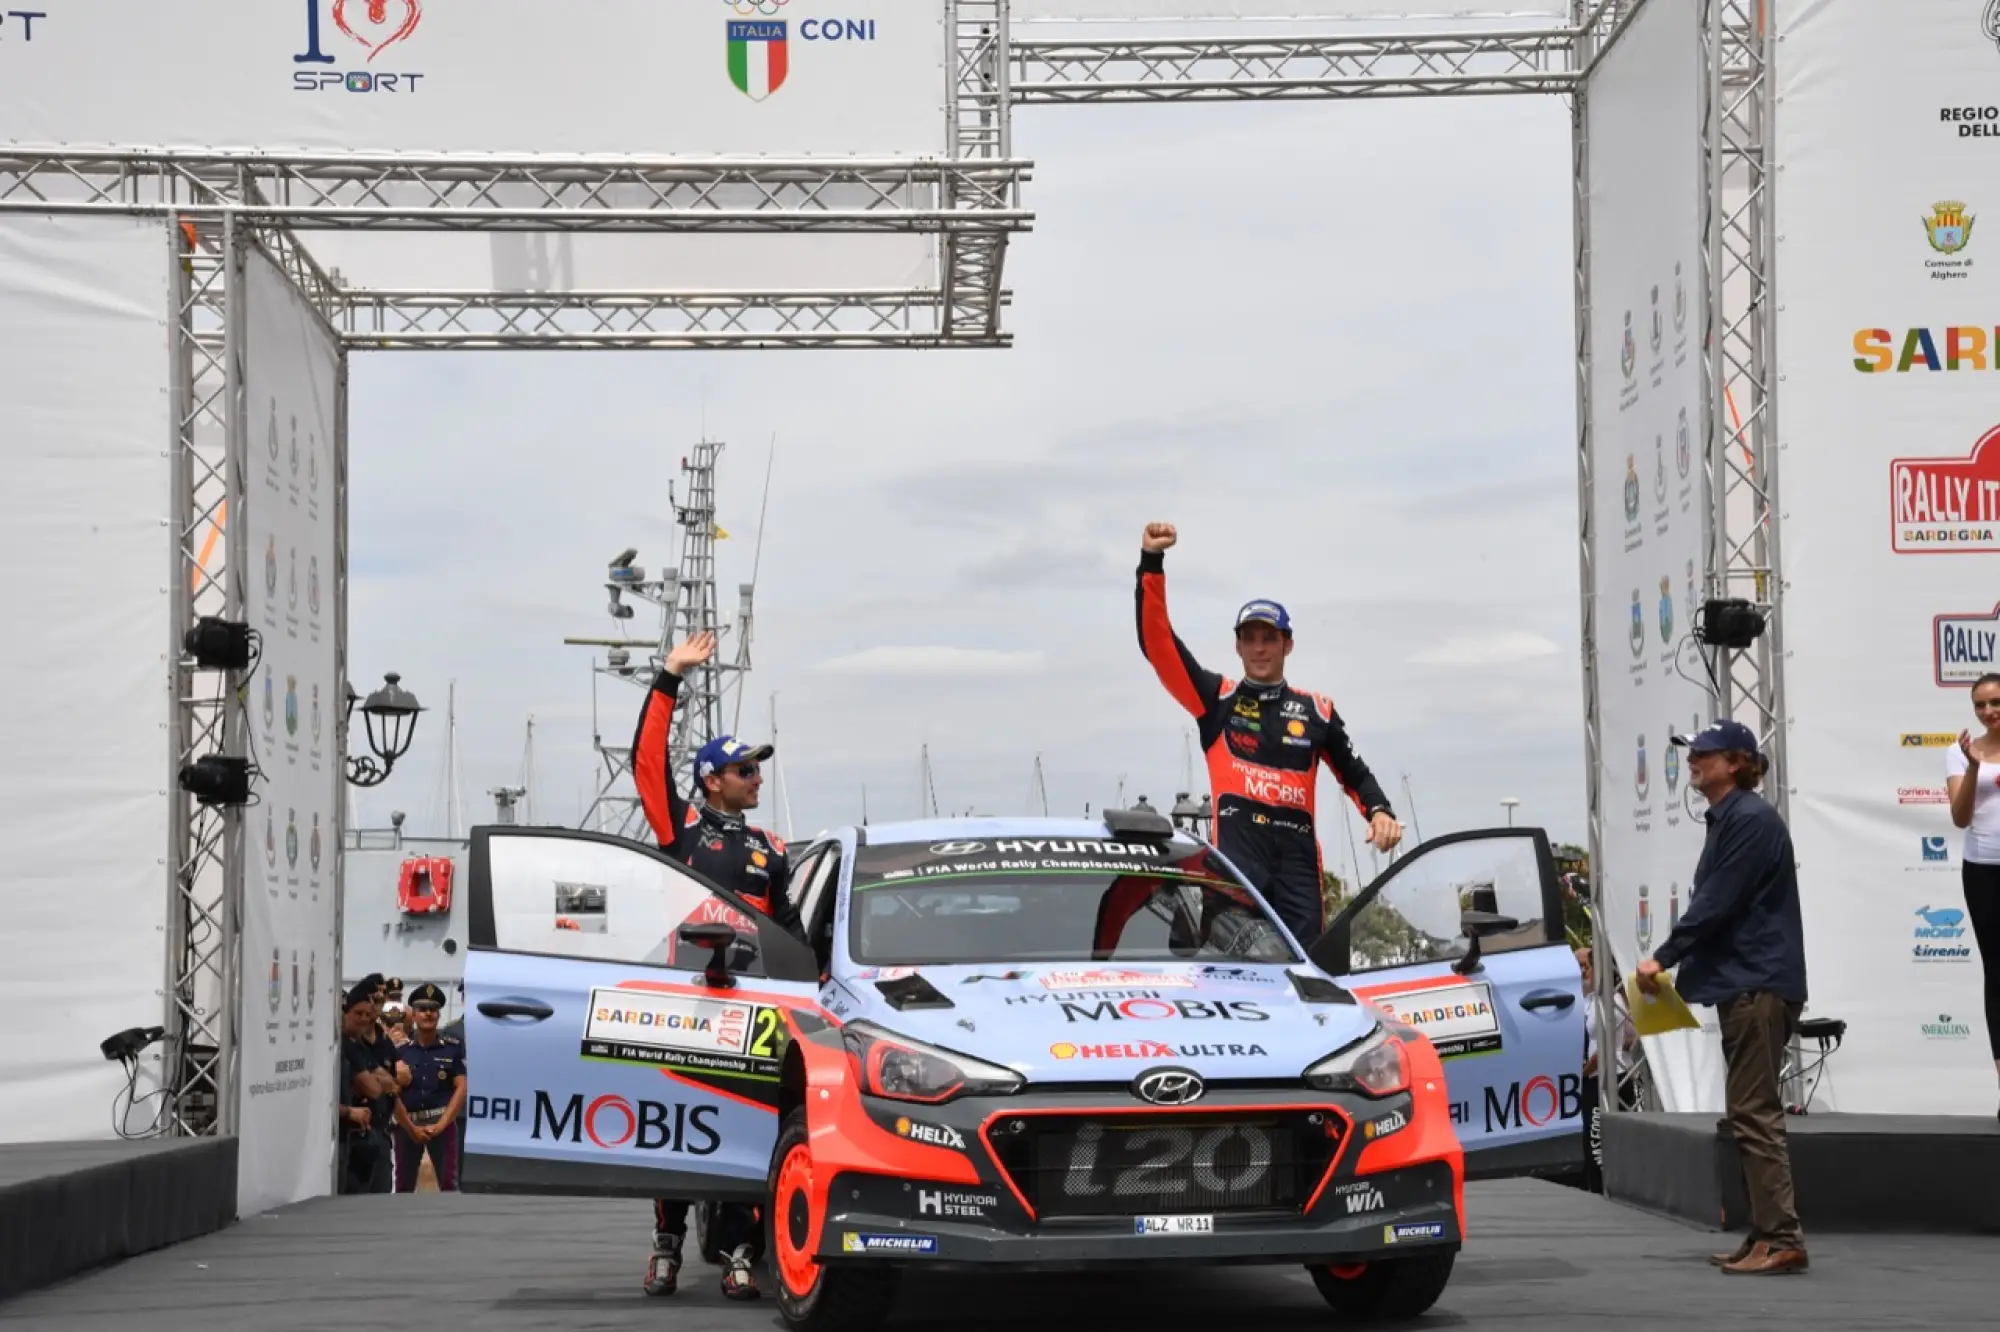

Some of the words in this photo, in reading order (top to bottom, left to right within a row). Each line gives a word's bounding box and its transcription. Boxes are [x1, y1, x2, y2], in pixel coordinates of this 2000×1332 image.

[732, 25, 783, 37] ITALIA
[800, 18, 875, 40] CONI
[293, 71, 424, 93] SPORT
[1940, 106, 1999, 122] REGIO
[1924, 259, 1962, 268] Comune
[1964, 258, 1973, 267] di
[1930, 270, 1968, 280] Alghero
[1853, 325, 2000, 373] SAR
[1898, 466, 1971, 522] RALLY
[1904, 529, 1993, 542] SARDEGNA
[1944, 624, 1996, 663] RALLY
[1244, 778, 1306, 806] MOBIS
[996, 839, 1160, 857] HYUNDAI
[926, 865, 950, 875] FIA
[954, 860, 997, 872] World
[1001, 858, 1037, 870] Rally
[1041, 858, 1143, 873] Championship
[1914, 927, 1966, 939] MOBY
[1911, 944, 1971, 957] tirrenia
[1004, 989, 1161, 1005] HYUNDAI
[1059, 999, 1271, 1023] MOBIS
[1400, 1002, 1490, 1026] SARDEGNA
[596, 1007, 713, 1033] SARDEGNA
[717, 1007, 746, 1049] 2016
[622, 1047, 636, 1057] FIA
[638, 1049, 663, 1061] World
[665, 1053, 686, 1065] Rally
[687, 1054, 747, 1071] Championship
[1081, 1040, 1178, 1059] HELIX
[1178, 1044, 1269, 1057] ULTRA
[531, 1089, 721, 1155] MOBIS
[1375, 1110, 1407, 1136] HELIX
[911, 1123, 967, 1149] HELIX
[1063, 1125, 1273, 1196] i20
[944, 1193, 998, 1206] HYUNDAI
[944, 1204, 984, 1216] STEEL
[1397, 1226, 1441, 1237] MICHELIN
[867, 1237, 932, 1249] MICHELIN
